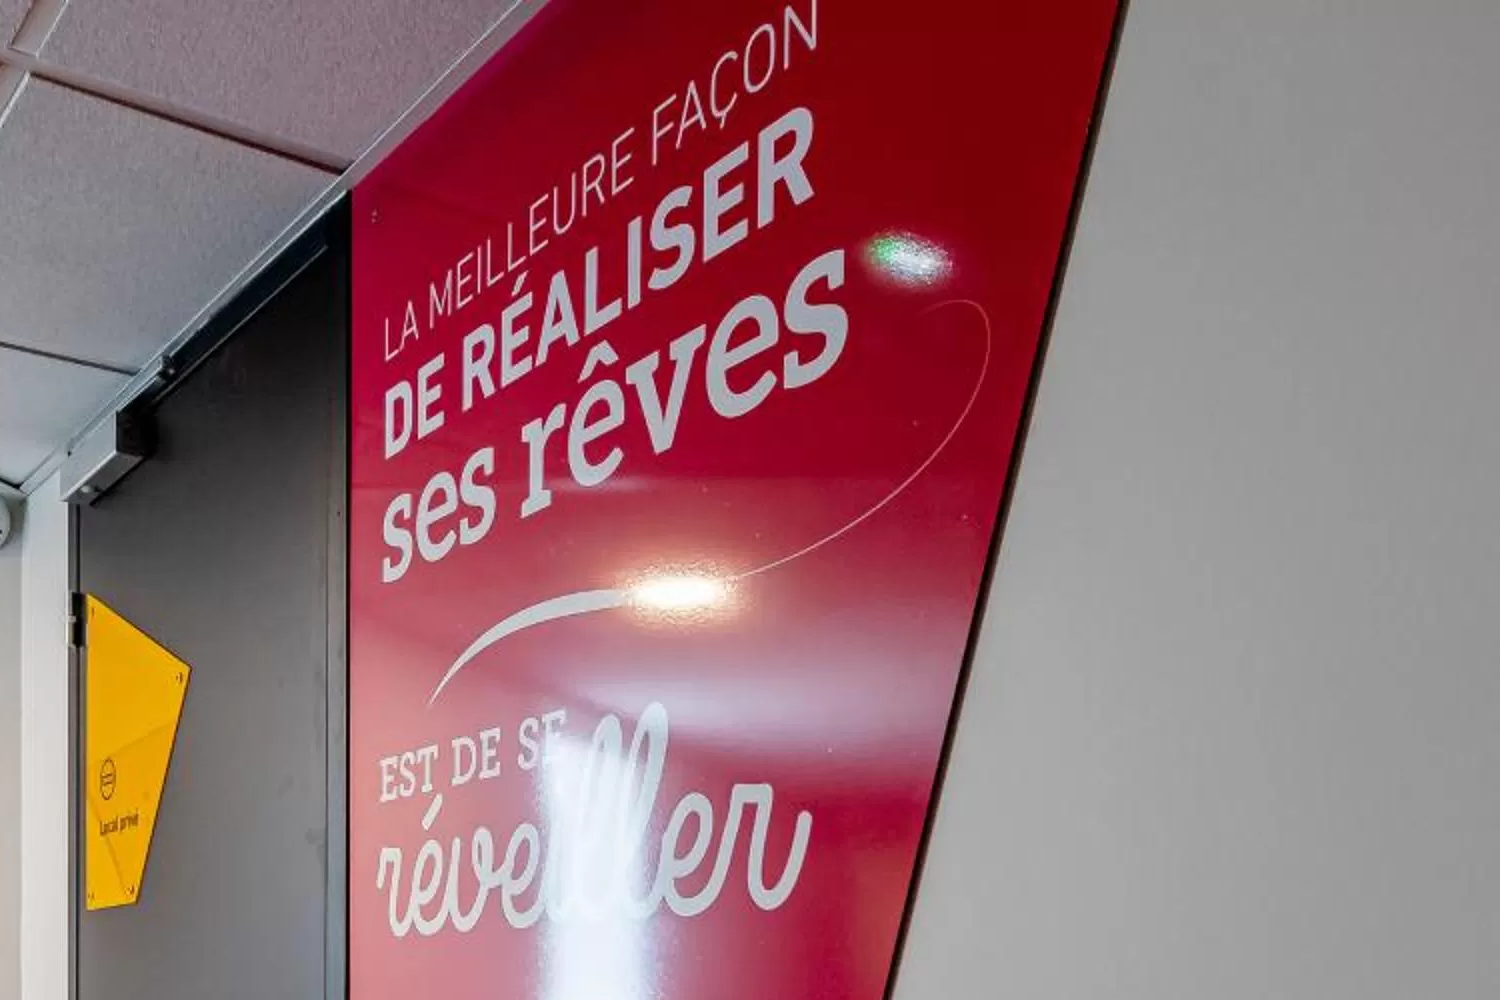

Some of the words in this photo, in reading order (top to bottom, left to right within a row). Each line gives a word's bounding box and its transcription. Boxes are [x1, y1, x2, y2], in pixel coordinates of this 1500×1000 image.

[384, 299, 420, 362] LA
[429, 127, 636, 330] MEILLEURE
[652, 0, 818, 167] FAÇON
[385, 353, 445, 461] DE
[461, 107, 816, 411] RÉALISER
[382, 446, 497, 584] ses
[520, 249, 849, 519] rêves
[379, 744, 440, 803] EST
[451, 726, 502, 787] DE
